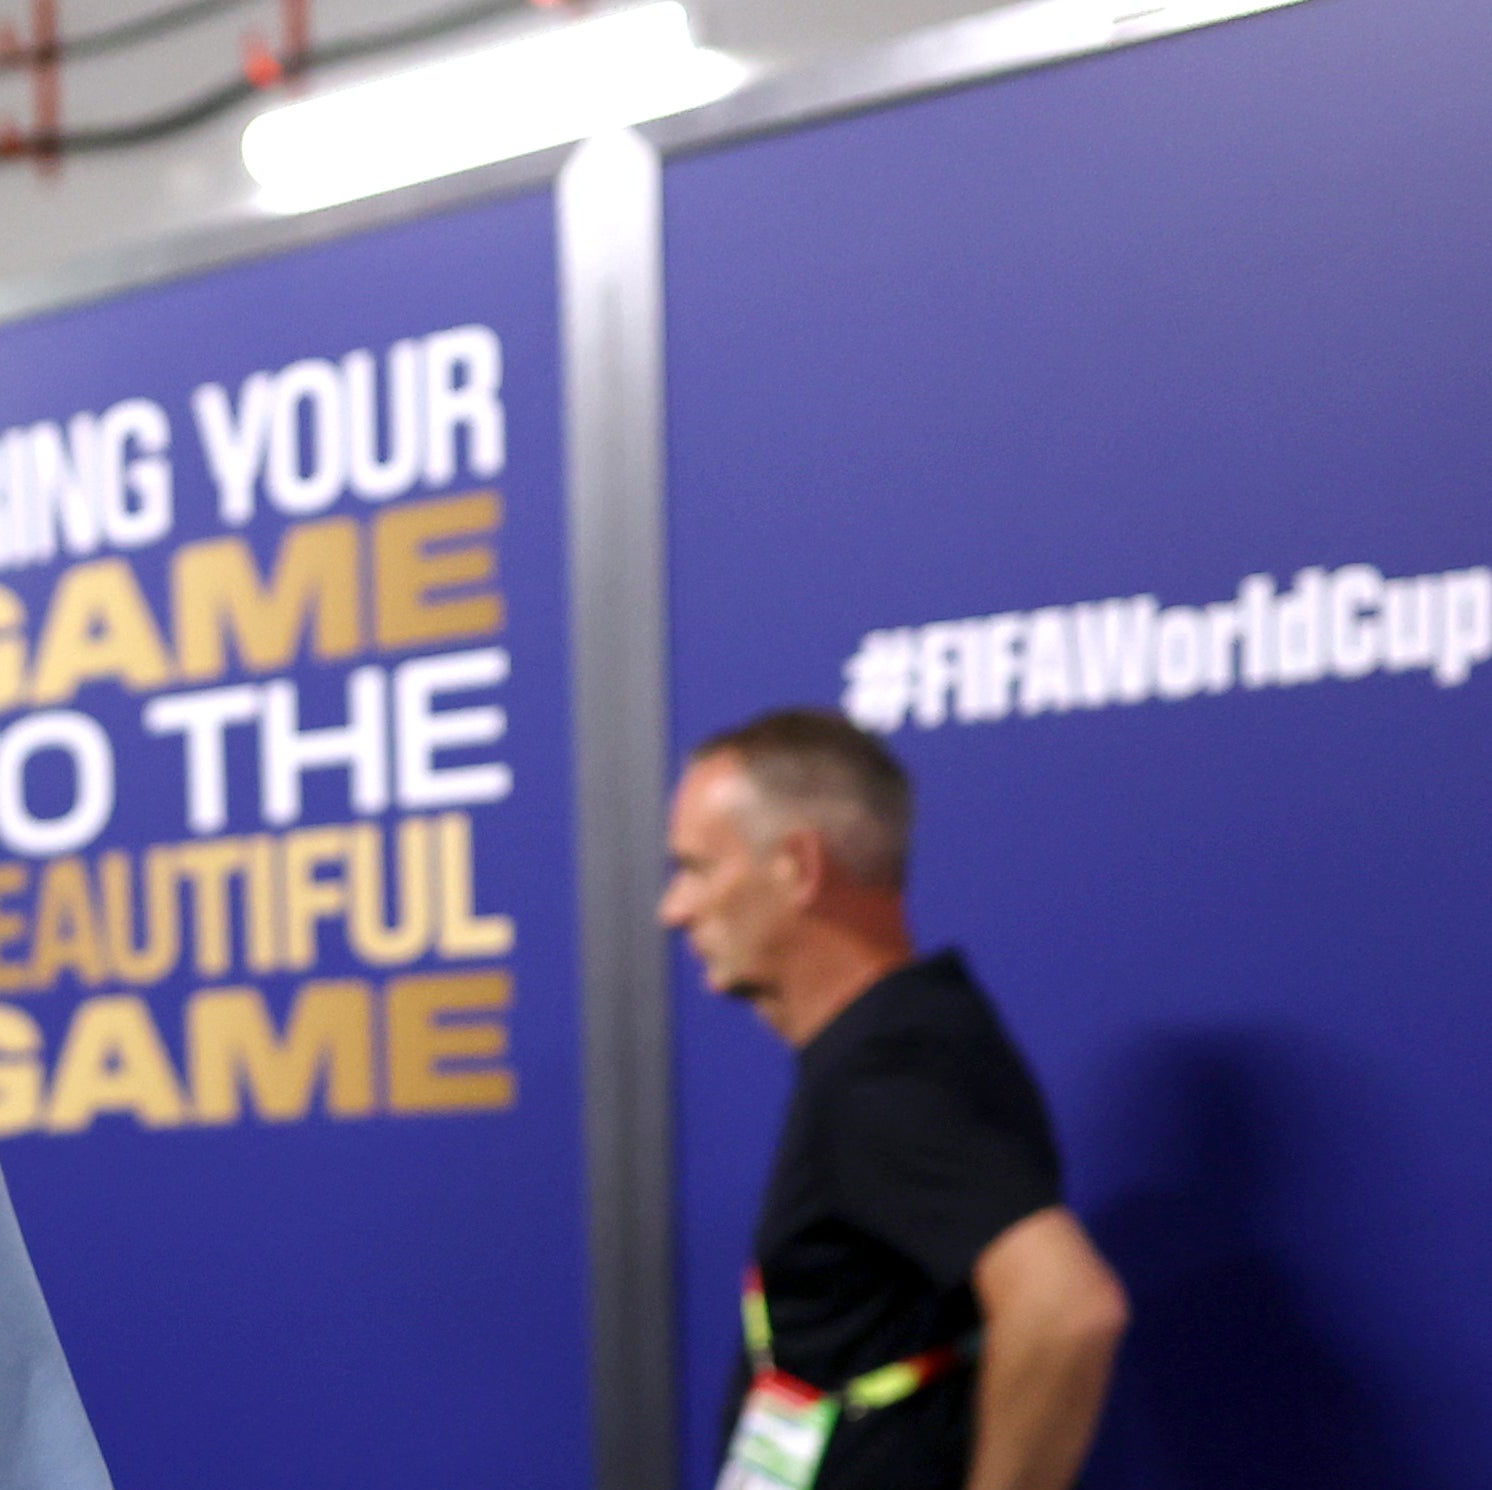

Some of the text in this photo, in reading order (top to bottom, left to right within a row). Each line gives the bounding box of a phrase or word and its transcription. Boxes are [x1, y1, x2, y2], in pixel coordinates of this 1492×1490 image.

[193, 324, 507, 526] YOUR
[143, 647, 513, 836] THE
[841, 562, 1492, 734] #FIFAWorldCup
